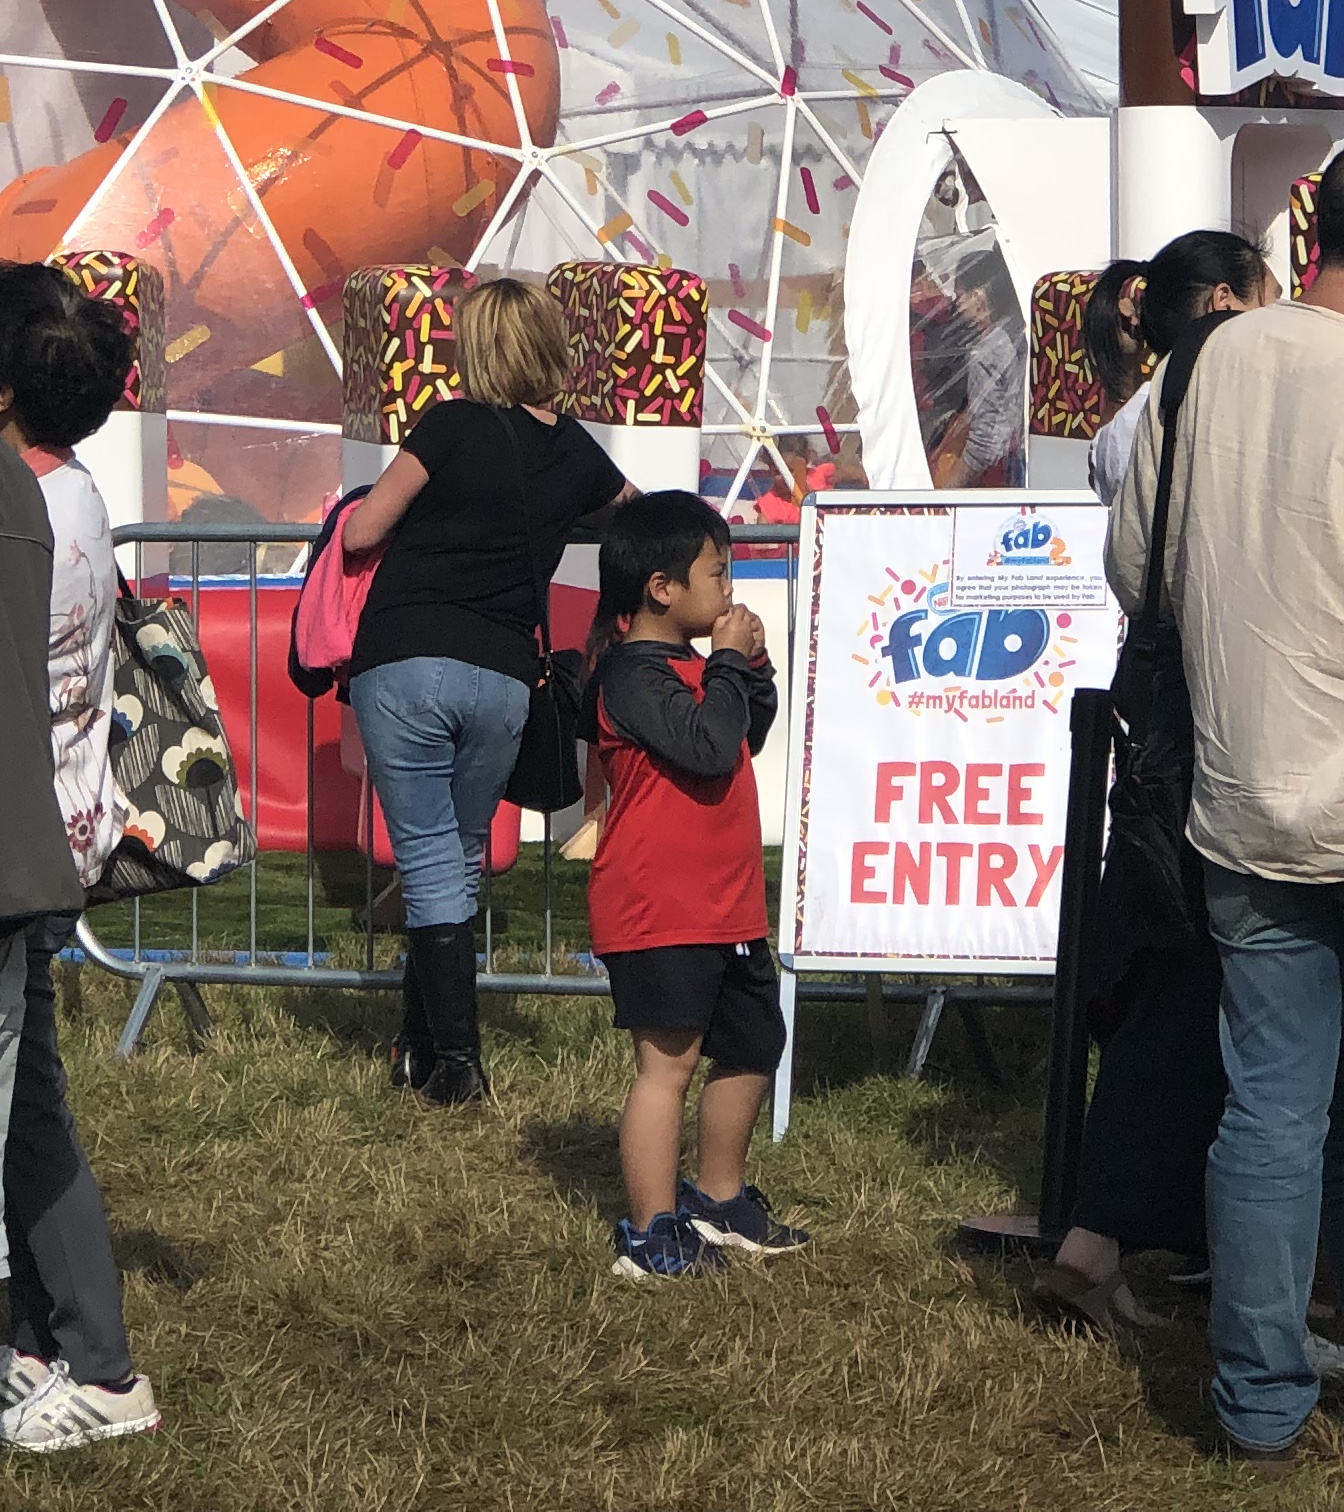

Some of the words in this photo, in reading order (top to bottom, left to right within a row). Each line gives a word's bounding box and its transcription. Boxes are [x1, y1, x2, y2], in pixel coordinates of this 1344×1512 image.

[1001, 521, 1052, 552] fab
[881, 609, 1050, 685] fab
[908, 689, 1035, 713] #myfabland
[874, 761, 1046, 826] FREE
[849, 841, 1065, 908] ENTRY
